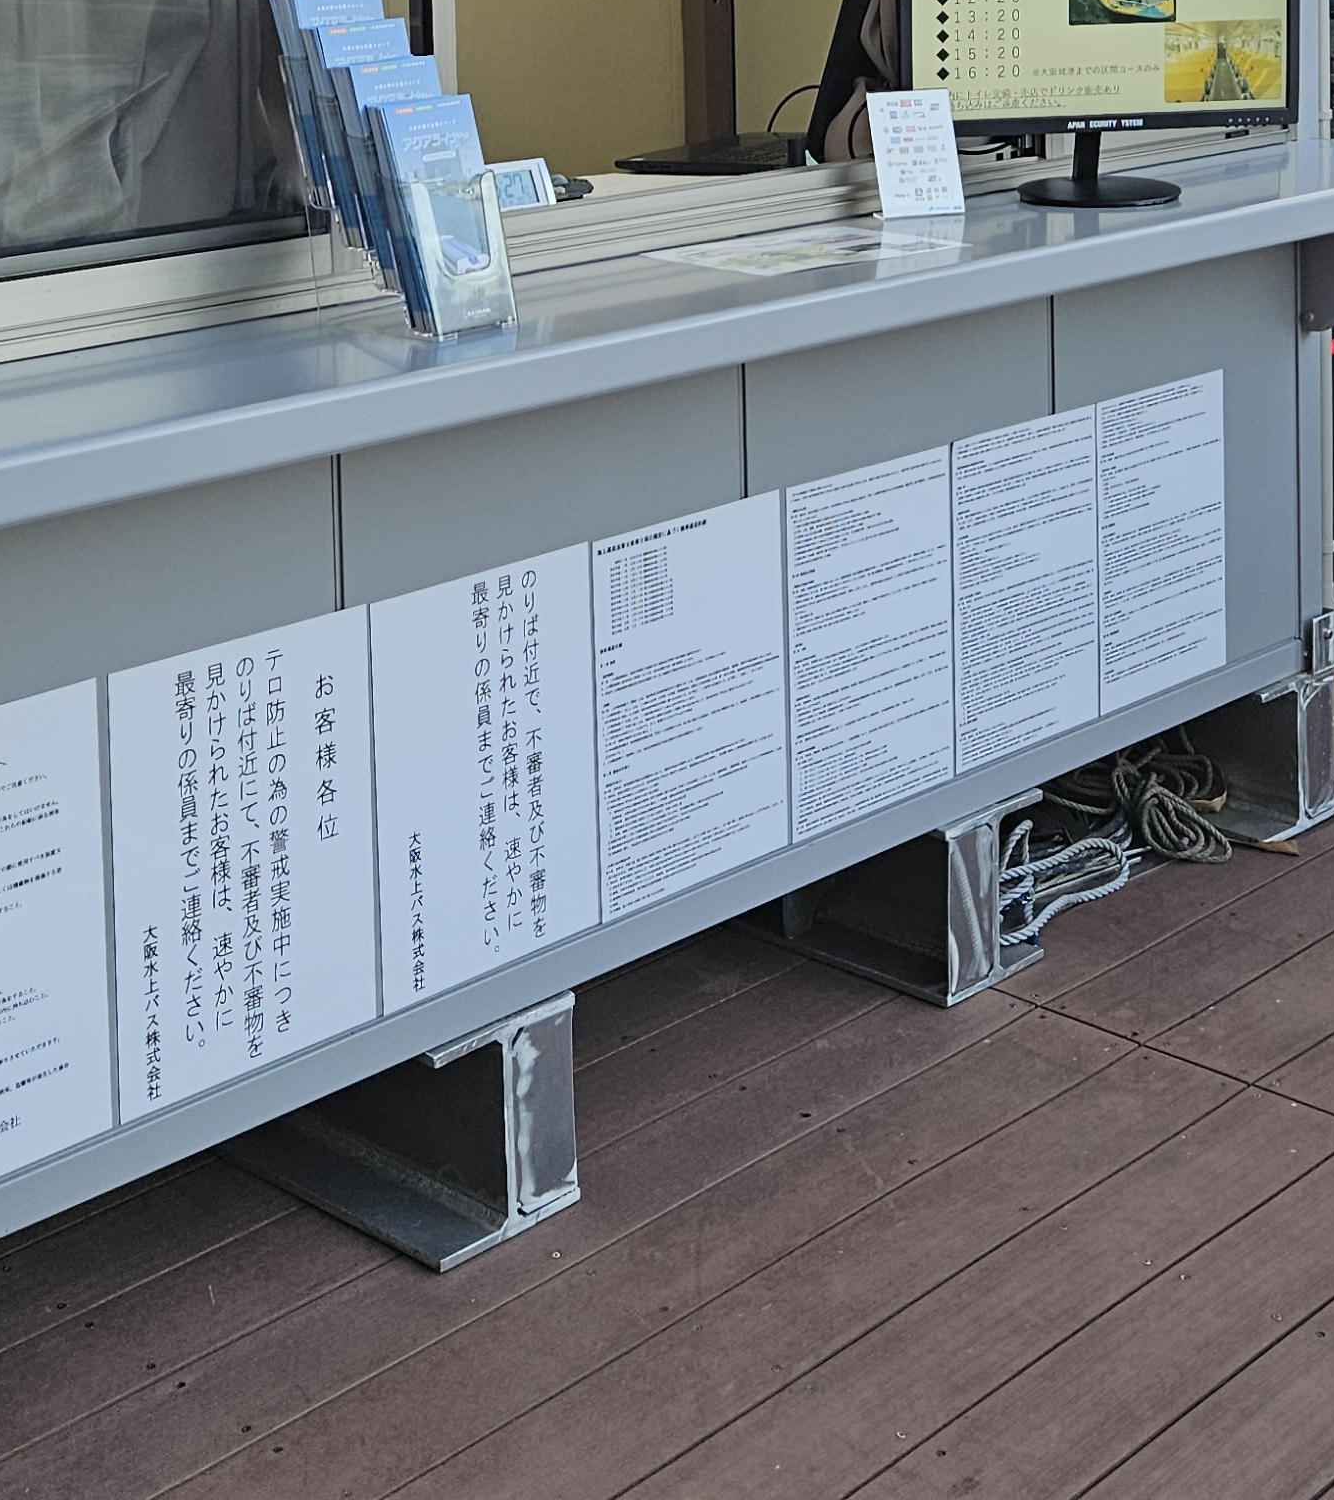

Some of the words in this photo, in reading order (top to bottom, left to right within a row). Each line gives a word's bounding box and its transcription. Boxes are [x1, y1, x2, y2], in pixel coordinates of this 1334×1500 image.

[955, 9, 1019, 23] 13:20
[955, 27, 1019, 42] 14:20
[955, 46, 1019, 60] 15:20
[955, 65, 1019, 80] 16:20
[1064, 120, 1085, 129] APAN
[1086, 119, 1117, 128] ECURITY
[1117, 118, 1143, 127] YSTEM
[265, 649, 291, 1032] テロ防止の為の警戒実施中につき
[315, 674, 339, 841] お客様各位
[472, 581, 499, 952] 最寄りの係員までご連絡ください。
[497, 575, 522, 931] 見かけられたお客様は、速やかに
[522, 570, 546, 937] のりば付近で、不審者及び不審物を
[175, 670, 205, 1047] 最寄りの係員までご連絡ください。
[205, 663, 233, 1031] 見かけられたお客様は、速やかに
[236, 658, 264, 1058] のりば付近にて、不審者及び不審物を
[409, 831, 425, 992] 大阪水上バス株式会社
[143, 925, 161, 1101] 大阪水上バス株式会社
